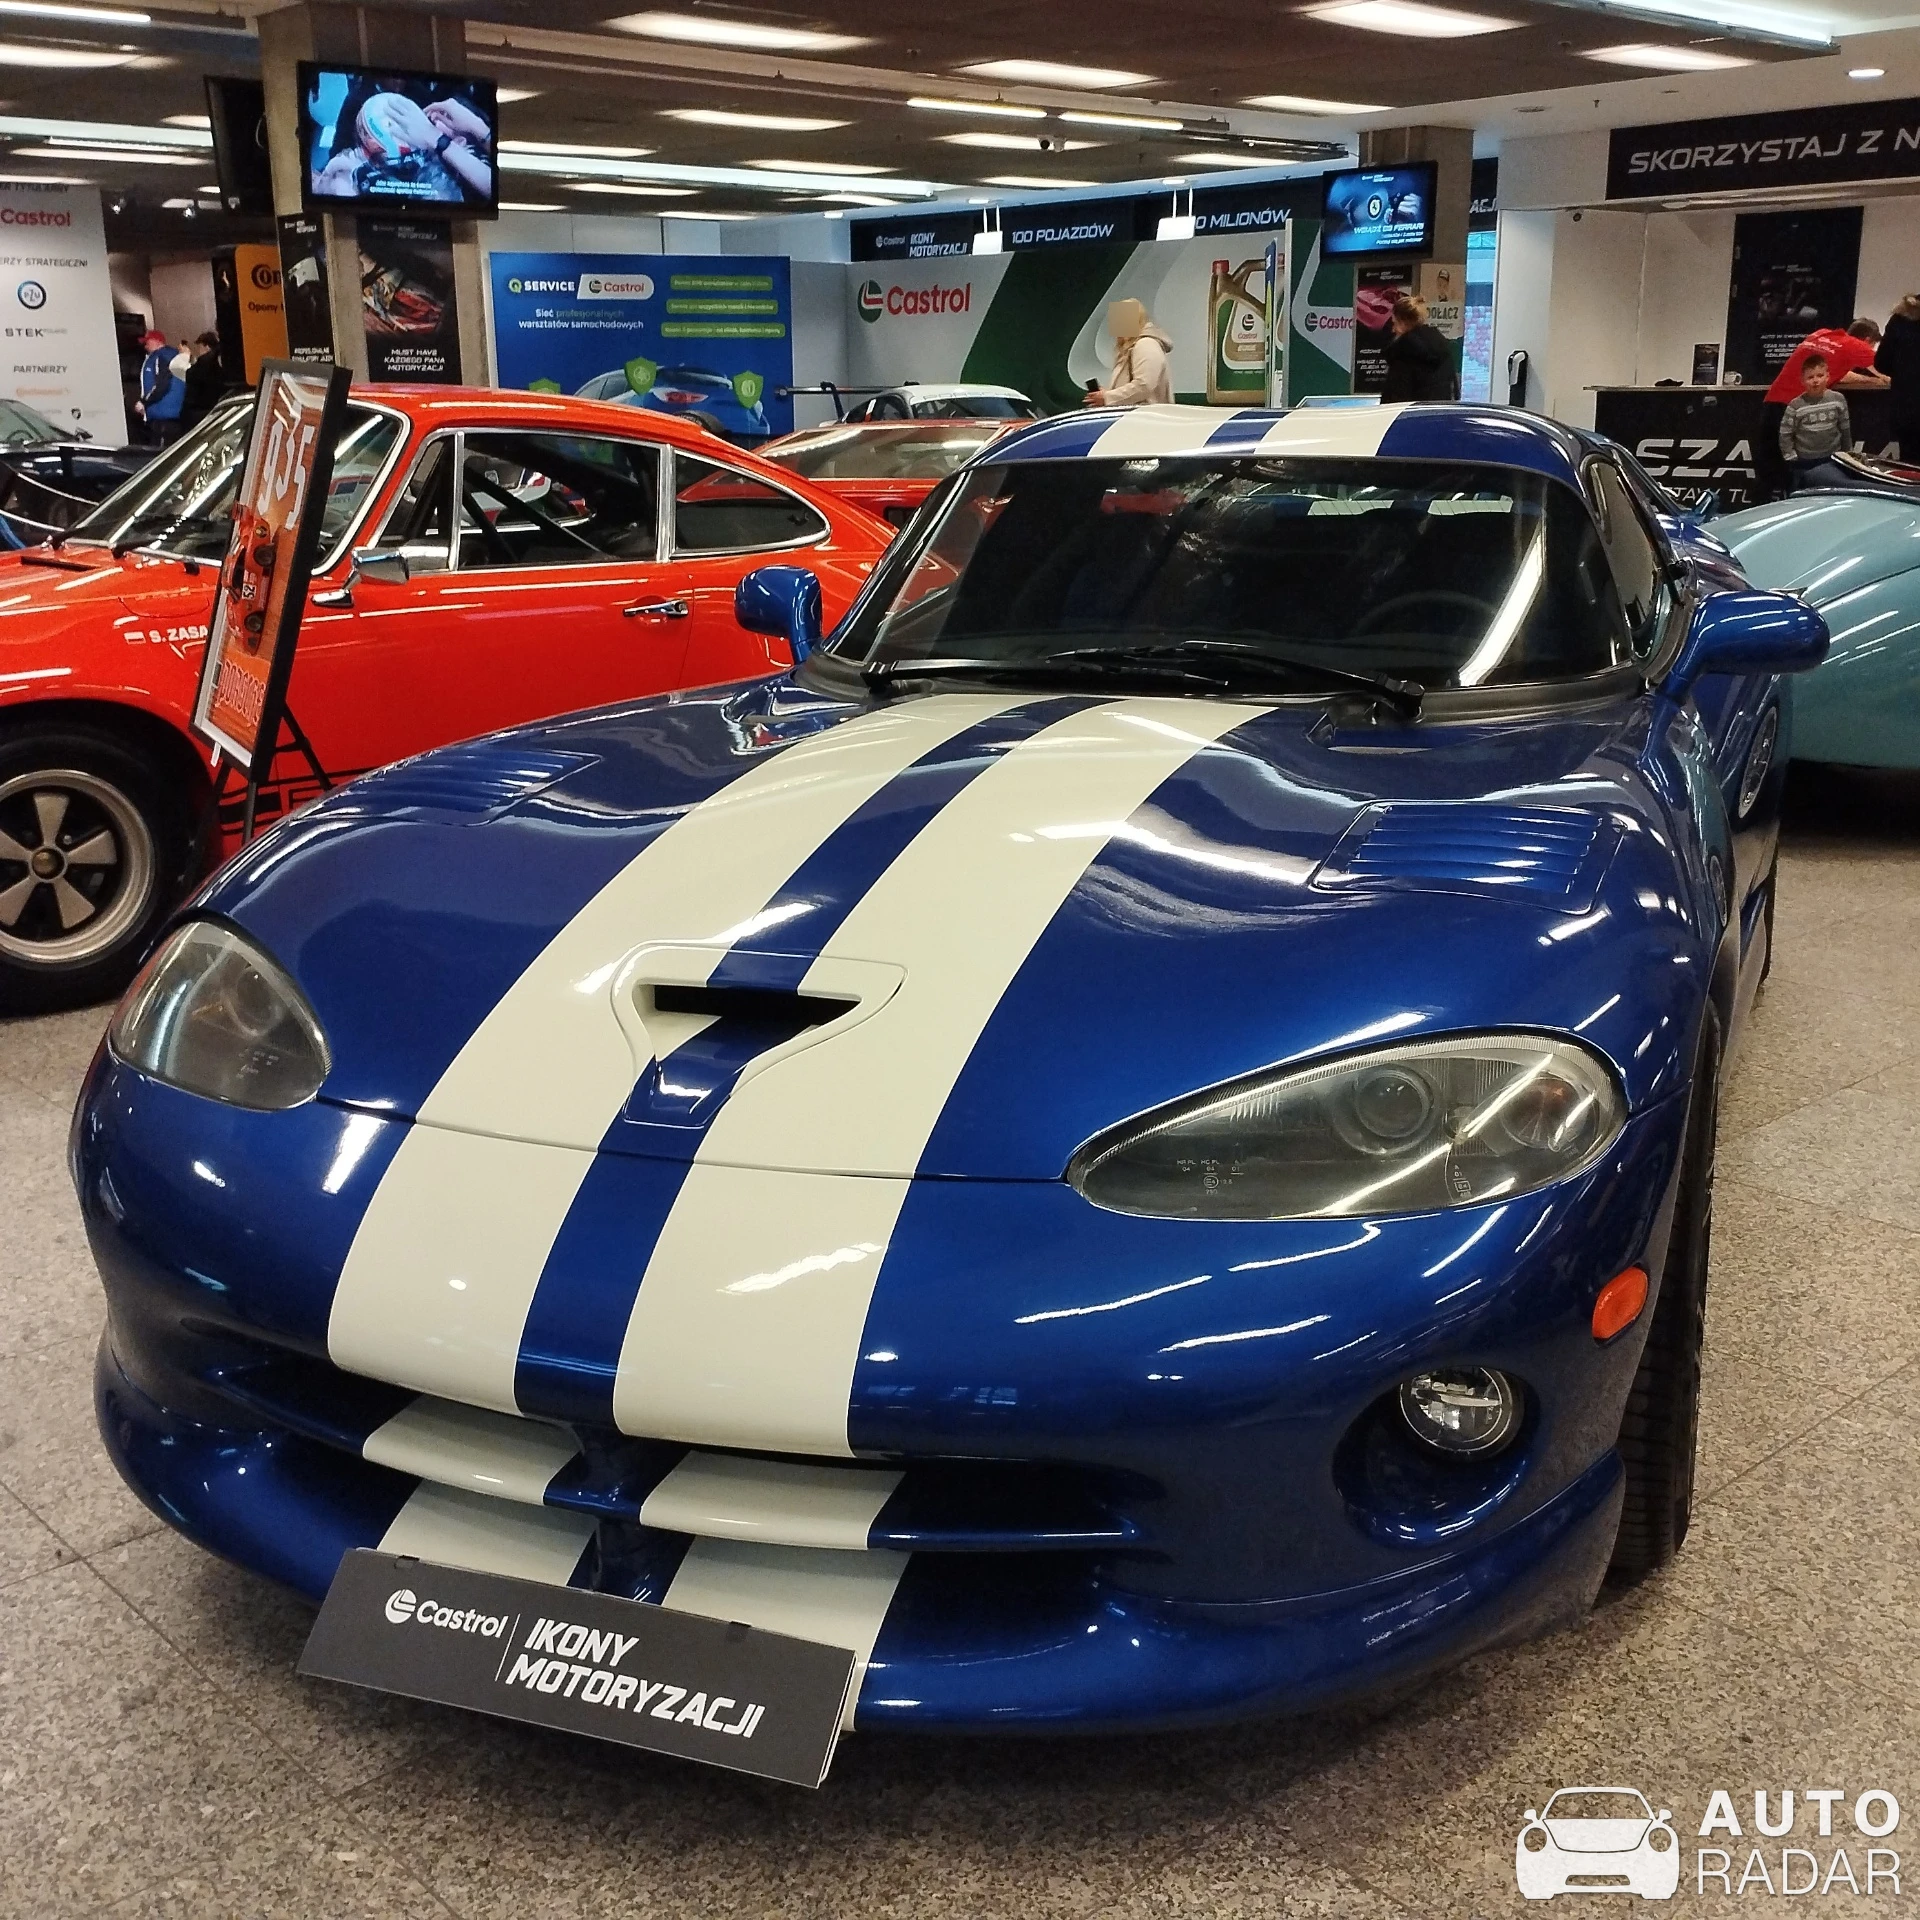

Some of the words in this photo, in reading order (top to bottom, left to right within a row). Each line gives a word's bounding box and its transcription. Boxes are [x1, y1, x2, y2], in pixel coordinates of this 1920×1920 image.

[1628, 133, 1847, 174] SKORZYSTAJ
[1857, 130, 1883, 154] Z
[0, 208, 70, 227] Castrol
[1210, 207, 1291, 228] MILIONÓW
[883, 235, 905, 246] Castrol
[910, 232, 935, 244] IKONY
[1012, 230, 1032, 244] 100
[1035, 223, 1114, 242] POJAZDÓW
[909, 242, 969, 257] MOTORYZACJI
[25, 258, 88, 267] STRATEGICZNI
[524, 281, 575, 292] SERVICE
[604, 283, 645, 293] Castrol
[887, 282, 971, 315] Castrol
[535, 308, 554, 318] Sieć
[5, 328, 43, 337] STEK
[519, 320, 569, 329] warsztatów
[571, 320, 644, 330] samochodowych
[13, 365, 68, 374] PARTNERZY
[242, 584, 256, 599] 52
[416, 1599, 509, 1639] Castrol
[524, 1618, 640, 1668] IKONY
[505, 1654, 766, 1740] MOTORYZACJI
